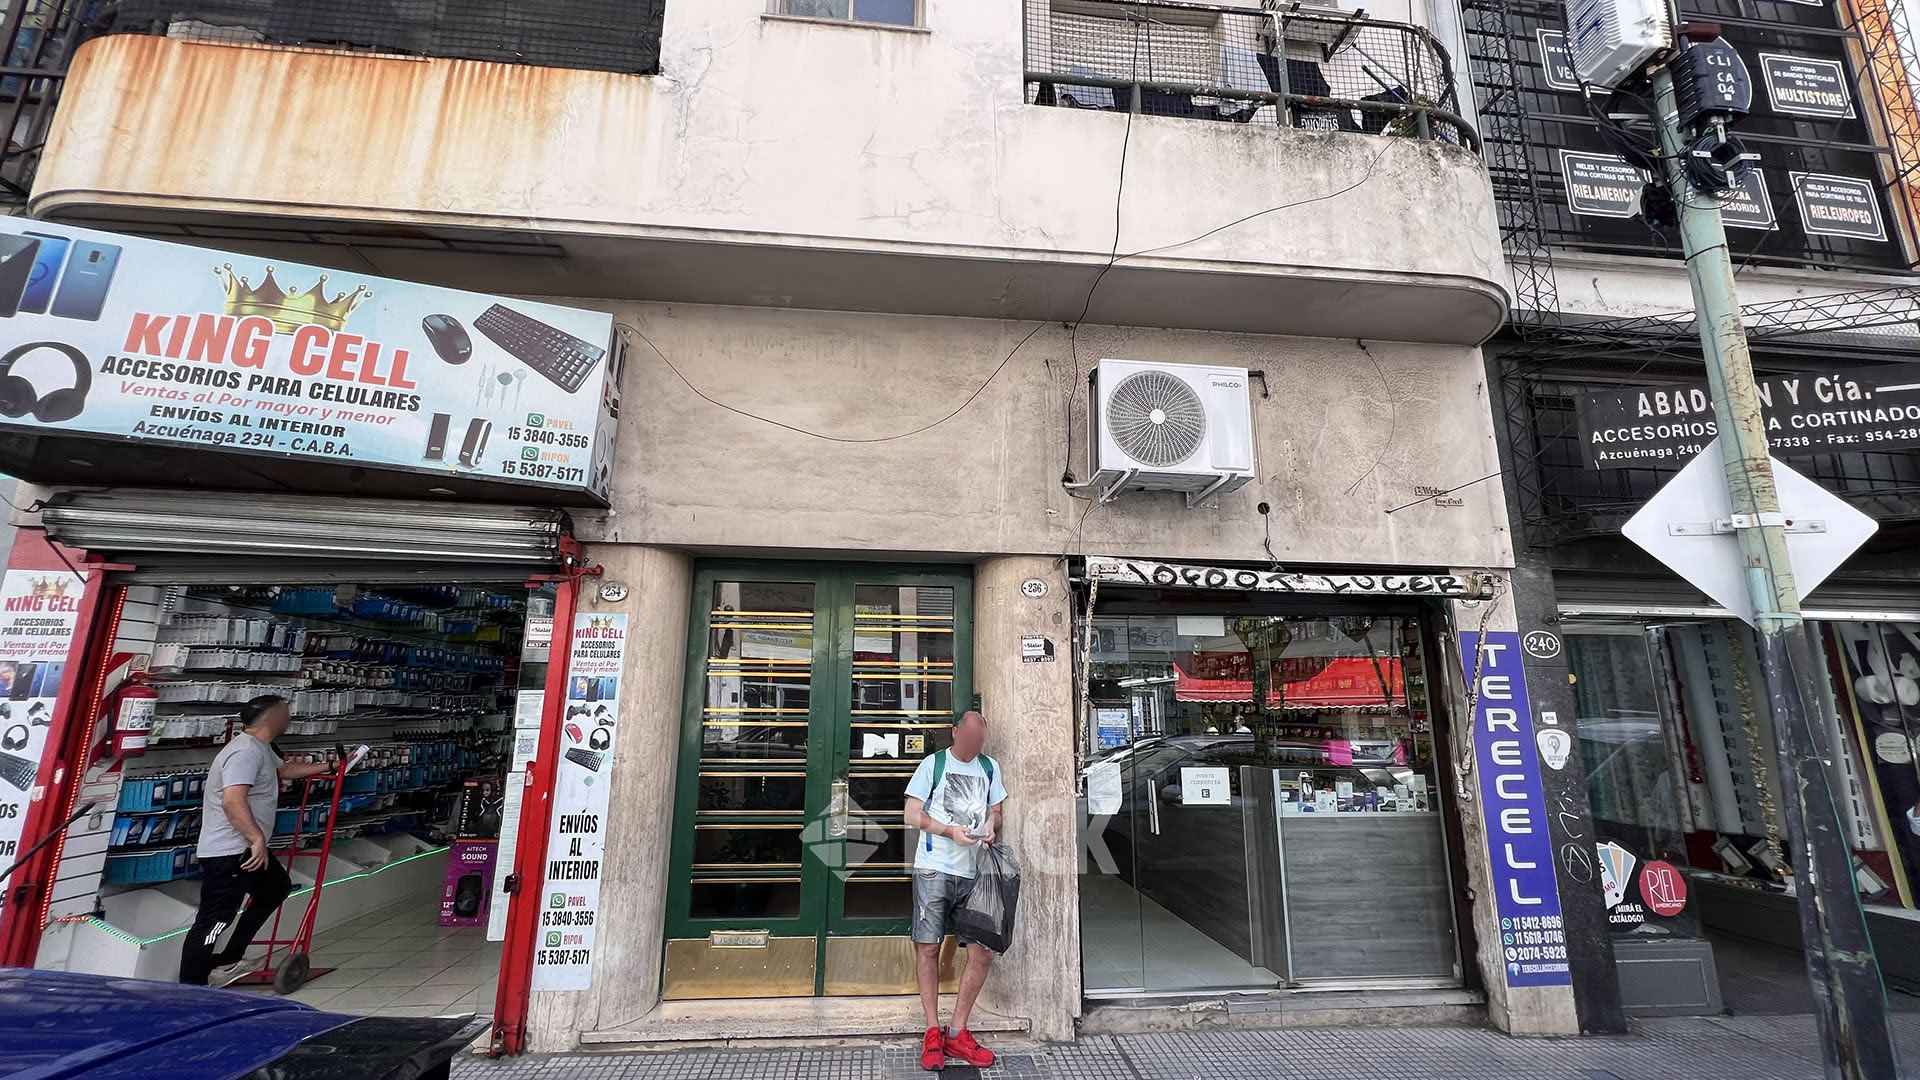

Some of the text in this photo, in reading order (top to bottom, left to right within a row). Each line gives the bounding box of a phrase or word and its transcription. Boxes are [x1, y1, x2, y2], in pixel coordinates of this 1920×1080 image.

[1707, 55, 1731, 67] CLI
[1717, 72, 1735, 83] CA
[1775, 87, 1844, 107] MULTISTORE
[1810, 204, 1872, 224] RIELEUROPEO
[124, 312, 417, 390] KING CELL
[100, 355, 421, 412] ACCESORIOS PARA CELULARES
[1782, 379, 1799, 405] Y
[1814, 374, 1872, 403] Cía.
[120, 380, 397, 425] Ventas al Por mayor y menor
[150, 404, 346, 438] ENVÍOS AL INTERIOR
[132, 420, 236, 446] Azcuénaga
[242, 432, 274, 447] 234
[290, 438, 354, 457] C.A.B.A.
[507, 426, 588, 449] 15 3840-3556
[1592, 422, 1718, 444] ACCESORIOS
[1600, 447, 1673, 460] Azcuénaga
[1678, 444, 1702, 455] 240
[1827, 434, 1860, 444] Fax:
[502, 460, 584, 481] 15 5387-5171
[1028, 583, 1042, 593] 236
[5, 595, 44, 612] KING
[13, 618, 65, 626] ACCESORIOS
[1, 627, 71, 636] PARA CELULARES
[575, 627, 624, 639] KING CELL
[580, 640, 615, 649] ACCESORIOS
[1529, 636, 1556, 651] 240
[573, 650, 621, 659] PARA CELULARES
[1475, 643, 1542, 905] TERECELL
[559, 808, 599, 834] ENVÍOS
[569, 837, 583, 857] AL
[461, 853, 488, 861] SOUND
[548, 860, 599, 880] INTERIOR
[1646, 868, 1686, 912] RIEL
[567, 896, 586, 907] PAVEL
[542, 911, 594, 927] 15 3840-3556
[1513, 917, 1521, 930] 11
[1609, 915, 1645, 923] CATÁLOGO!
[1515, 932, 1523, 945] 11
[537, 949, 590, 965] 15 5387-5171
[1517, 946, 1567, 960] 2074-5928
